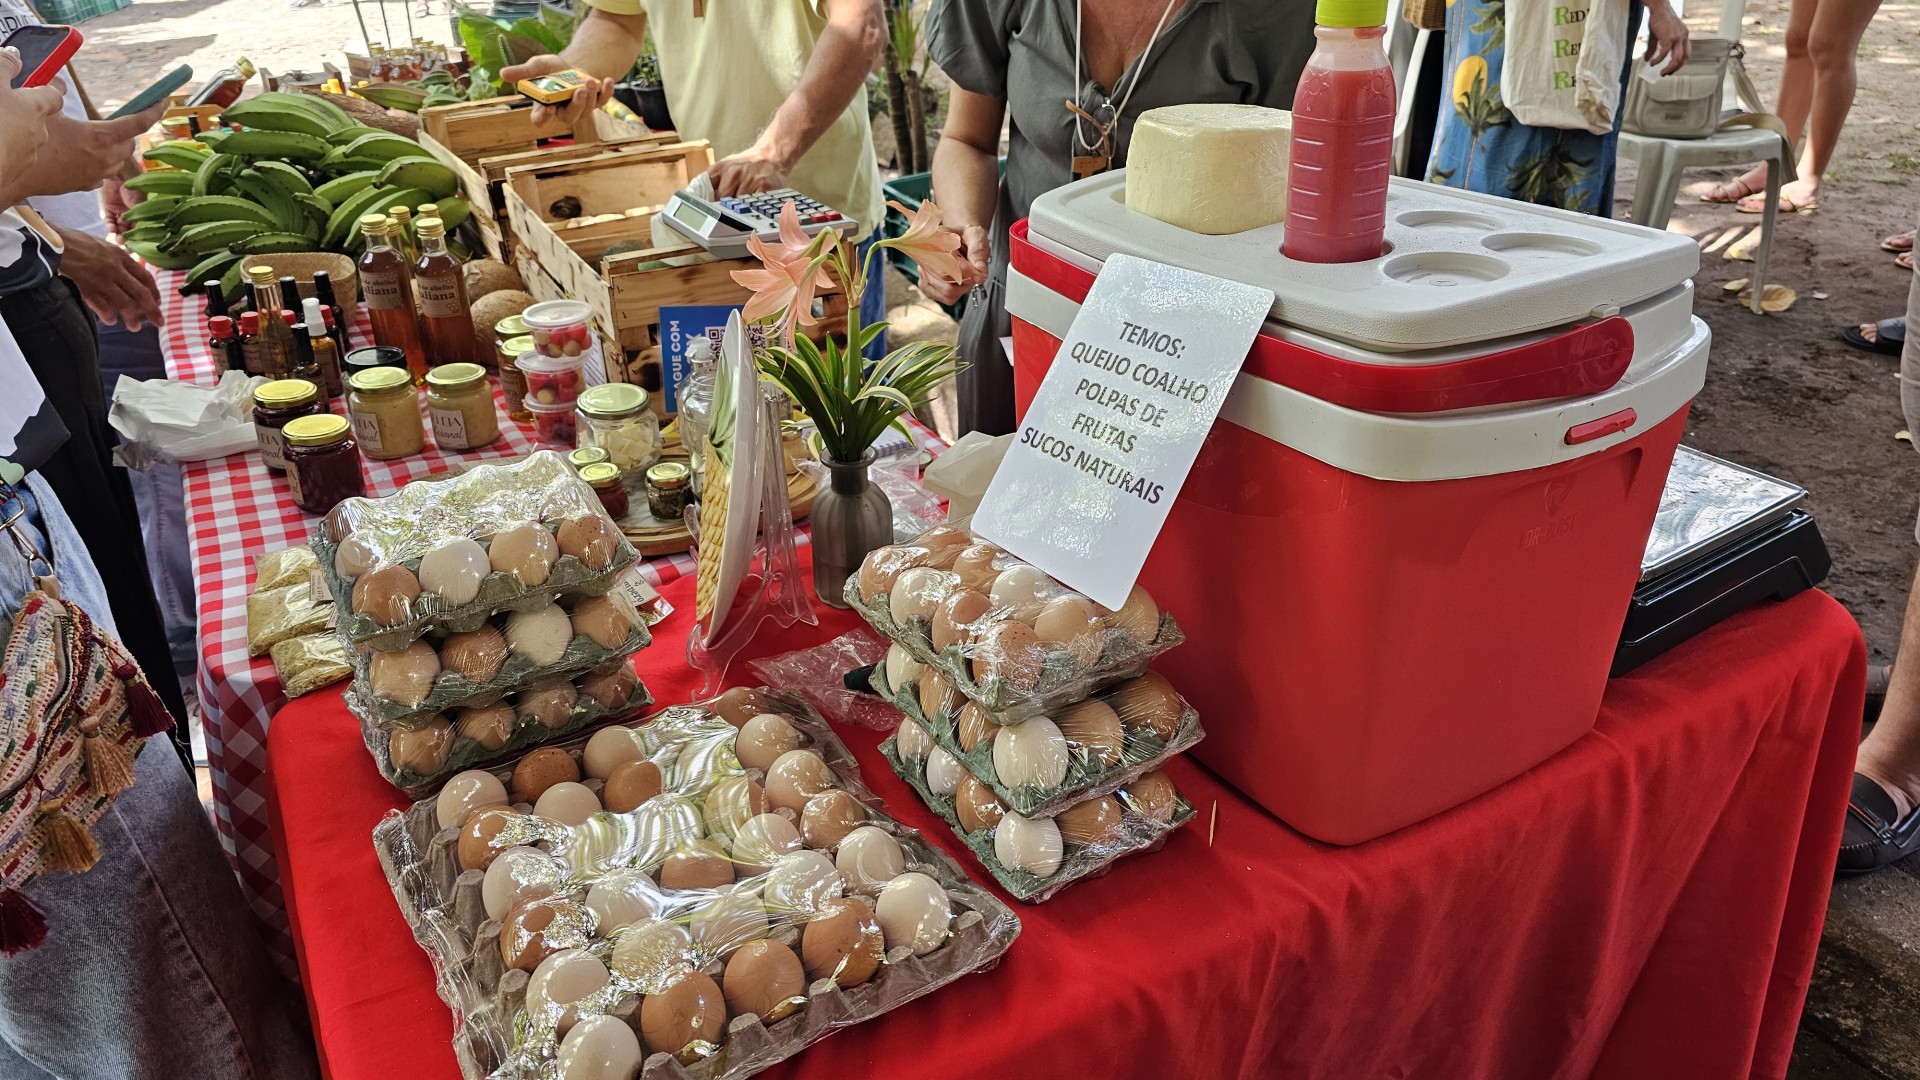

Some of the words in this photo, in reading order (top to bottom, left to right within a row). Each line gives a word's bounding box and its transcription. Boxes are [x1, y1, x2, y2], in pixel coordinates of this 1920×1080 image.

[1553, 6, 1590, 26] RED
[1553, 39, 1581, 58] RE
[363, 286, 398, 295] aliana
[670, 320, 682, 353] COM
[1118, 321, 1187, 359] TEMOS:
[1070, 341, 1131, 376] QUEIJO
[1132, 363, 1209, 405] COALHO
[1074, 378, 1138, 416] POLPAS
[1141, 402, 1169, 428] DE
[1072, 413, 1138, 454] FRUTAS
[1020, 427, 1075, 464] SUCOS
[1074, 450, 1165, 504] NATURAIS
[623, 579, 645, 603] mpero
